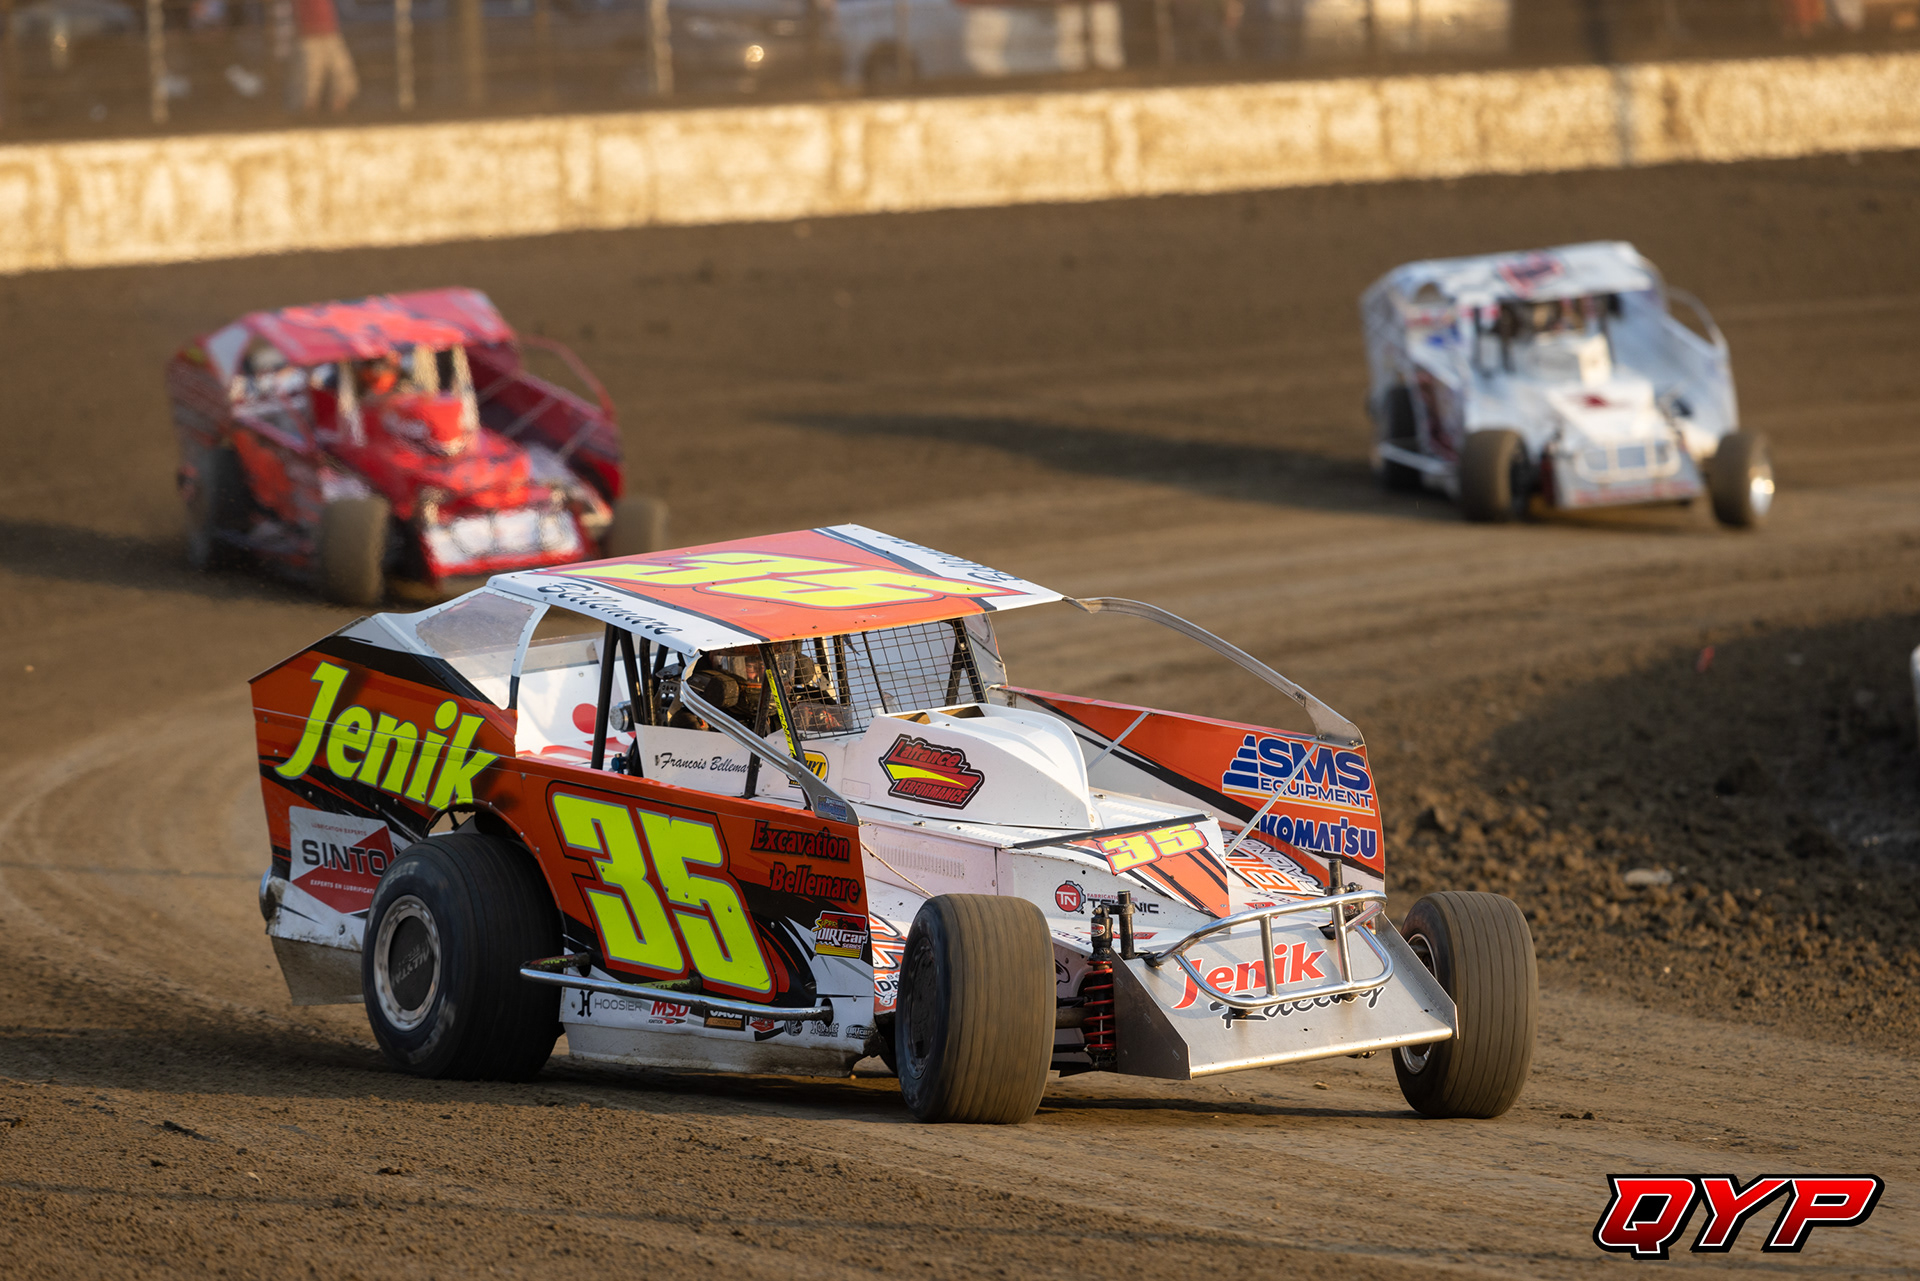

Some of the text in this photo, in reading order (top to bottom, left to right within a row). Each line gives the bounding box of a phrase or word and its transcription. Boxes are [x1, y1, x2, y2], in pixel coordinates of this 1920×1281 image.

[554, 552, 1010, 608] 35
[274, 659, 500, 811] Jenik
[659, 752, 707, 770] Francois
[887, 741, 962, 774] Lafrance
[1258, 737, 1371, 791] SMS
[1261, 777, 1373, 807] EQUIPMENT
[751, 820, 850, 862] Excavation
[1100, 823, 1205, 871] 35
[1259, 816, 1377, 859] KOMATSU
[310, 879, 334, 889] EXPERTS
[334, 881, 343, 890] EN
[552, 791, 772, 994] 35
[770, 862, 861, 904] Bellemare
[1171, 941, 1328, 1009] Jenik
[594, 998, 643, 1012] HOOSIER
[650, 1001, 690, 1018] MSD
